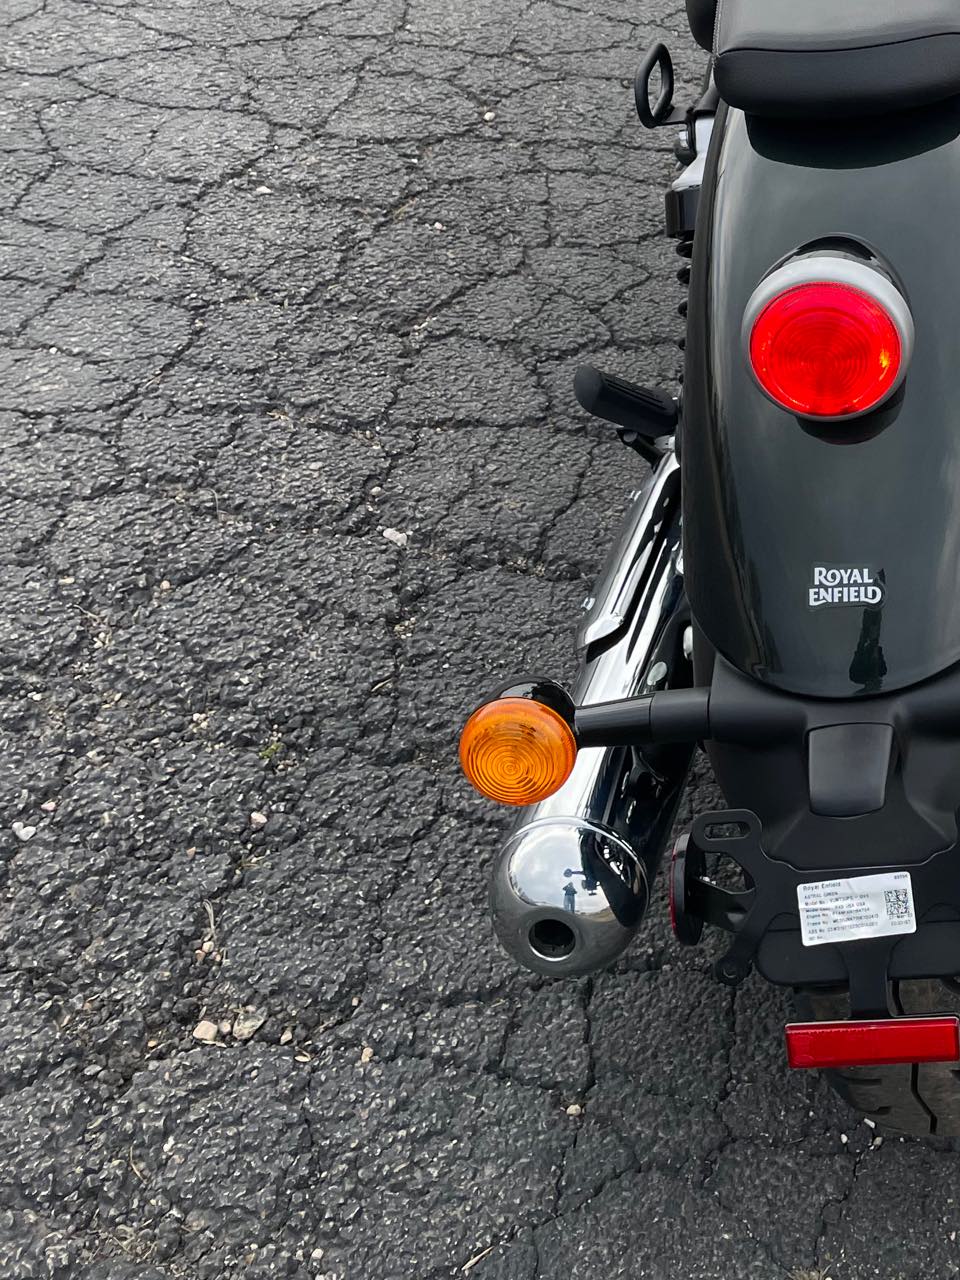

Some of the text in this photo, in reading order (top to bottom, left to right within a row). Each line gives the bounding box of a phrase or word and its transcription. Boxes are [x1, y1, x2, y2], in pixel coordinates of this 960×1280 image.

[814, 567, 873, 586] ROYAL
[808, 585, 882, 606] ENFIELD
[821, 881, 841, 889] Enfield
